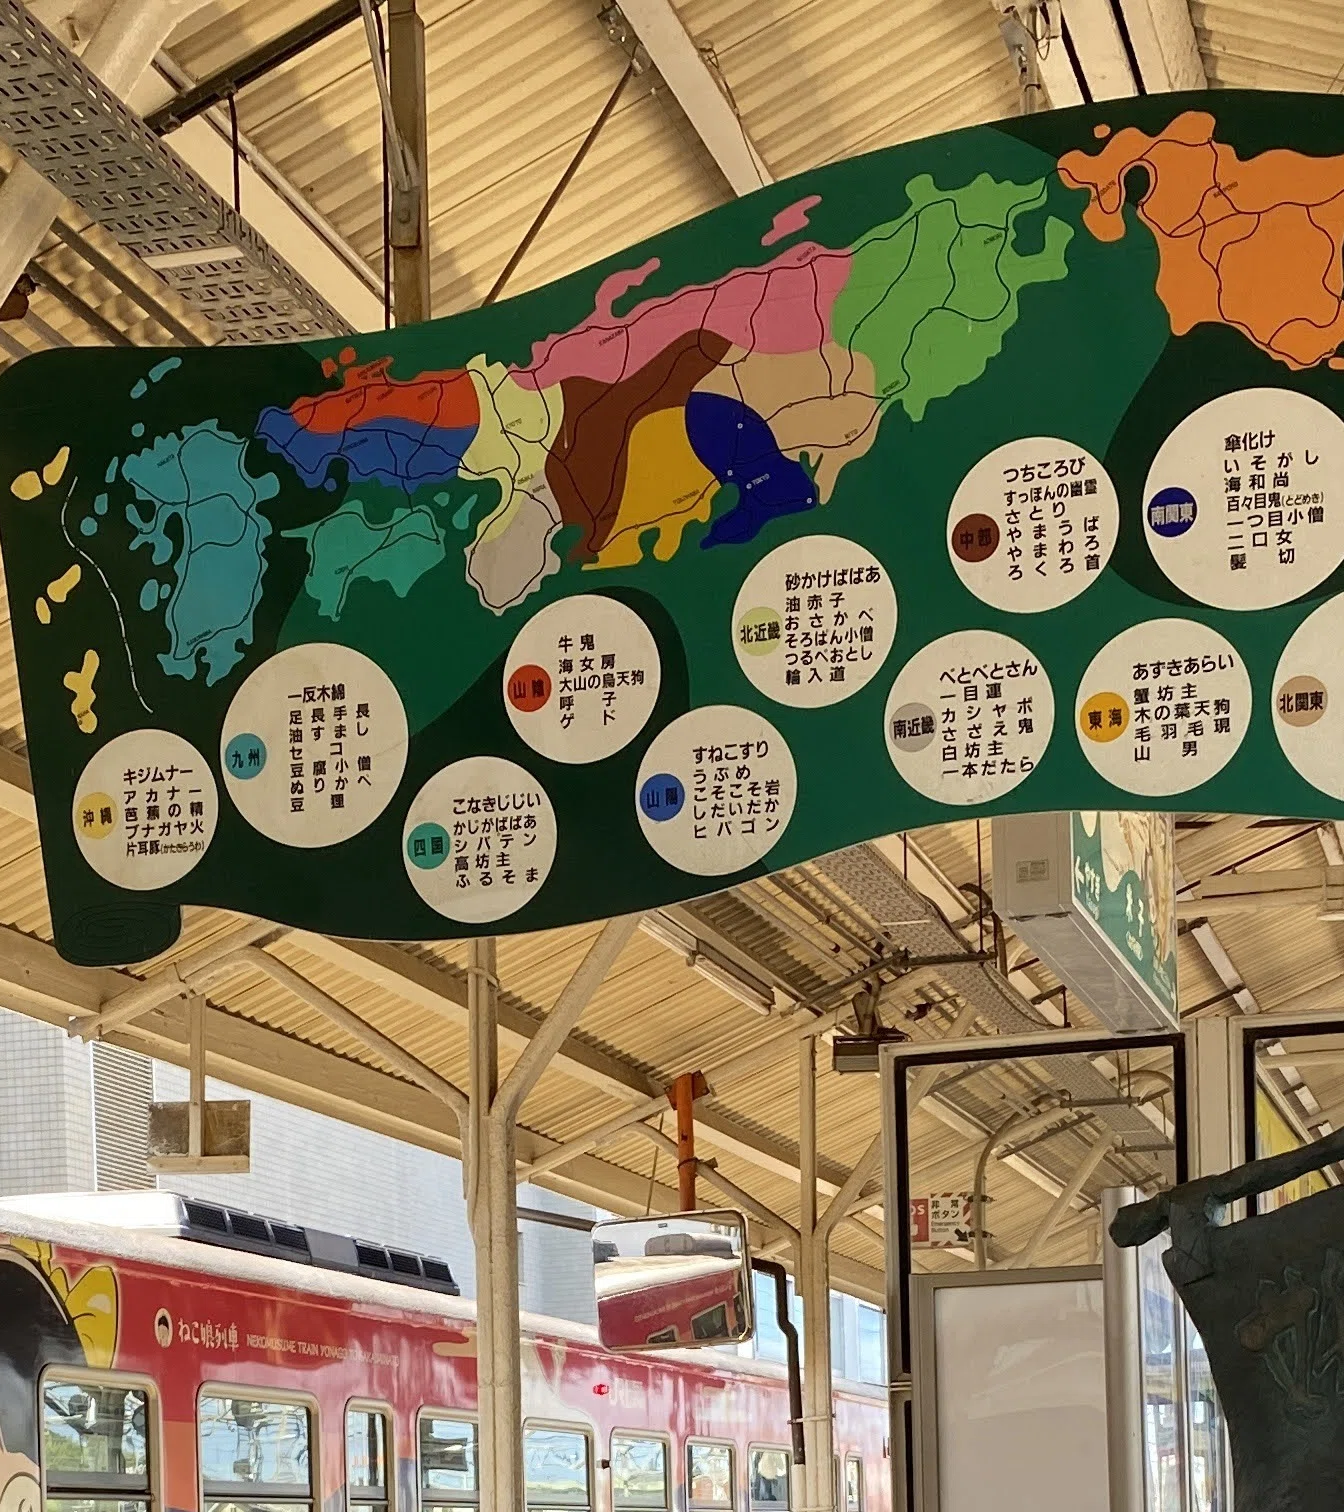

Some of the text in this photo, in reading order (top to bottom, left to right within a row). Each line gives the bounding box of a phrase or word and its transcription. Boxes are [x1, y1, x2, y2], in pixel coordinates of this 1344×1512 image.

[1224, 430, 1275, 452] 傘化け
[1003, 457, 1085, 482] つちころび
[1224, 450, 1319, 473] いそがし
[1004, 479, 1097, 506] すっぽんの幽霊
[1224, 472, 1289, 493] 海和尚
[1006, 502, 1065, 524] さとり
[1151, 502, 1194, 526] 南関東
[1227, 507, 1324, 527] 一つ目小僧
[959, 528, 992, 550] 中部
[1228, 529, 1293, 550] 二口女
[786, 566, 881, 591] 砂かけばばあ
[786, 592, 845, 612] 油赤子
[558, 634, 594, 653] 牛鬼
[740, 621, 780, 644] 北近畿
[785, 626, 873, 648] そろばん小僧
[785, 645, 872, 666] つるべおとし
[940, 659, 1037, 684] べとべとさん
[1133, 654, 1234, 680] あずきあらい
[288, 683, 345, 703] 一反木綿
[1280, 691, 1323, 713] 北関東
[1088, 708, 1122, 730] 東海
[1135, 699, 1230, 723] 木の葉天狗
[893, 716, 934, 740] 南近畿
[232, 749, 260, 768] 九州
[693, 740, 768, 764] すねこすり
[123, 765, 193, 785] キジムナー
[694, 765, 750, 784] うぶめ
[943, 756, 1034, 778] 一本だたら
[124, 786, 202, 805] アカナー
[694, 780, 780, 802] こそこそ岩
[453, 793, 541, 814] こなきじじい
[694, 798, 779, 820] しだいだか
[83, 807, 112, 827] 沖縄
[454, 814, 536, 836] かじがばばあ
[414, 836, 443, 857] 四国
[455, 852, 510, 872] 高坊主
[178, 1318, 239, 1352] ねこ娘列車
